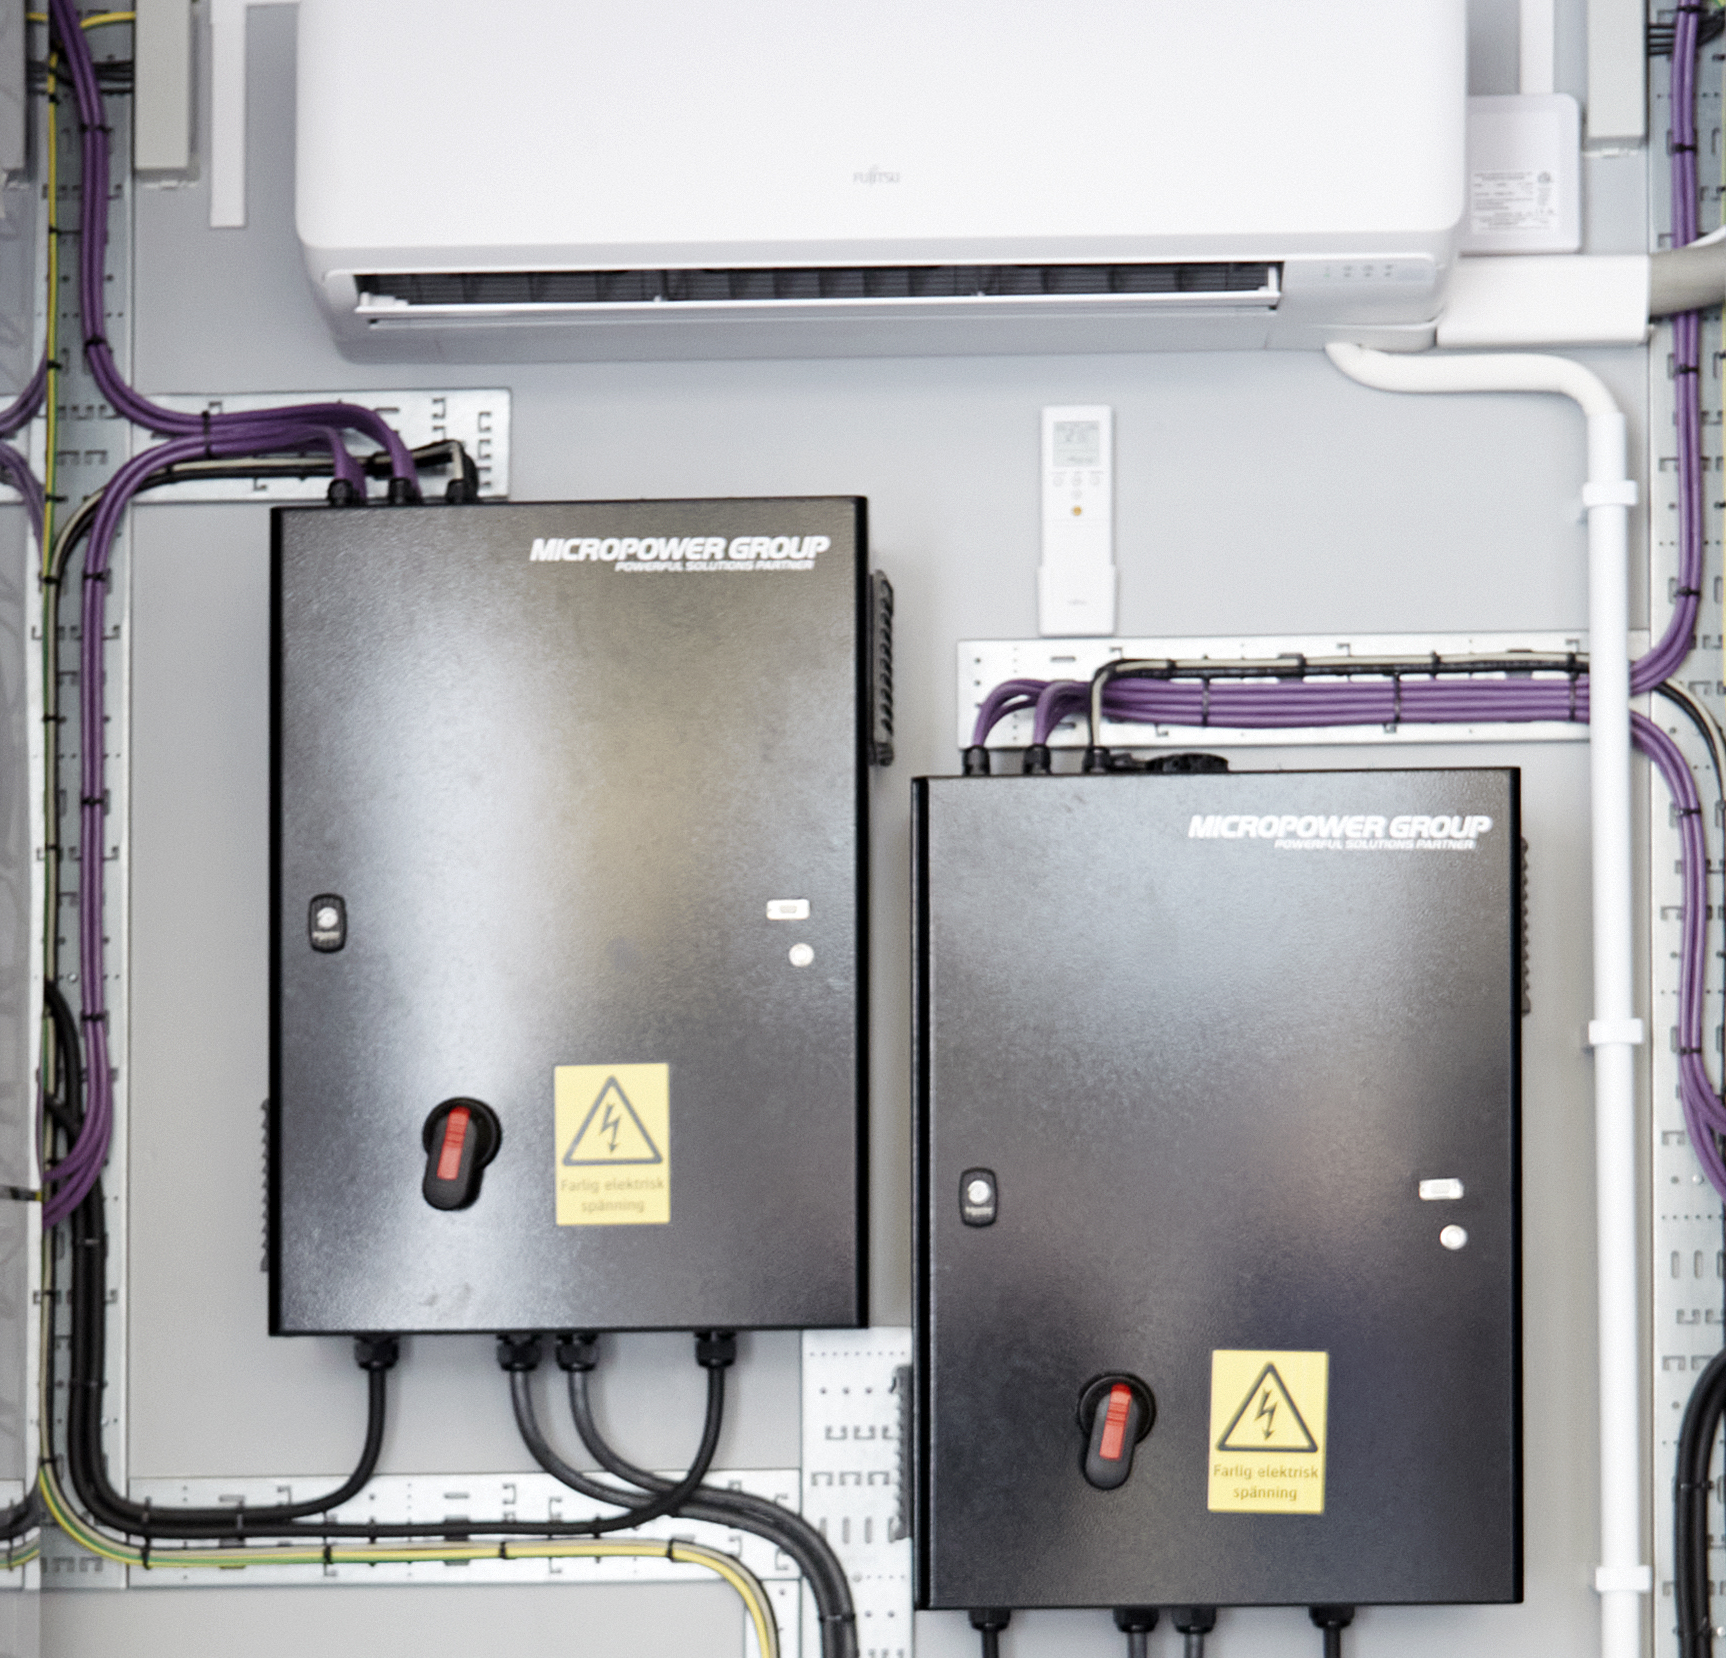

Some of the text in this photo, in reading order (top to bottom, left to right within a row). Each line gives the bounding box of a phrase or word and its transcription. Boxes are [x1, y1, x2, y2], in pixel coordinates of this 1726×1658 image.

[529, 535, 831, 562] MICROPOWER GROUP
[614, 561, 684, 573] POWERFUL
[685, 560, 754, 572] SOLUTIONS
[1188, 814, 1493, 839] MICROPOWER GROUP
[1273, 838, 1475, 850] POWERFUL SOLUTIONS PARTNER
[560, 1177, 664, 1194] Farlig elektrisk
[581, 1199, 646, 1214] spänning
[1213, 1463, 1319, 1480] Farlig elektrisk
[1233, 1485, 1298, 1502] spänning
